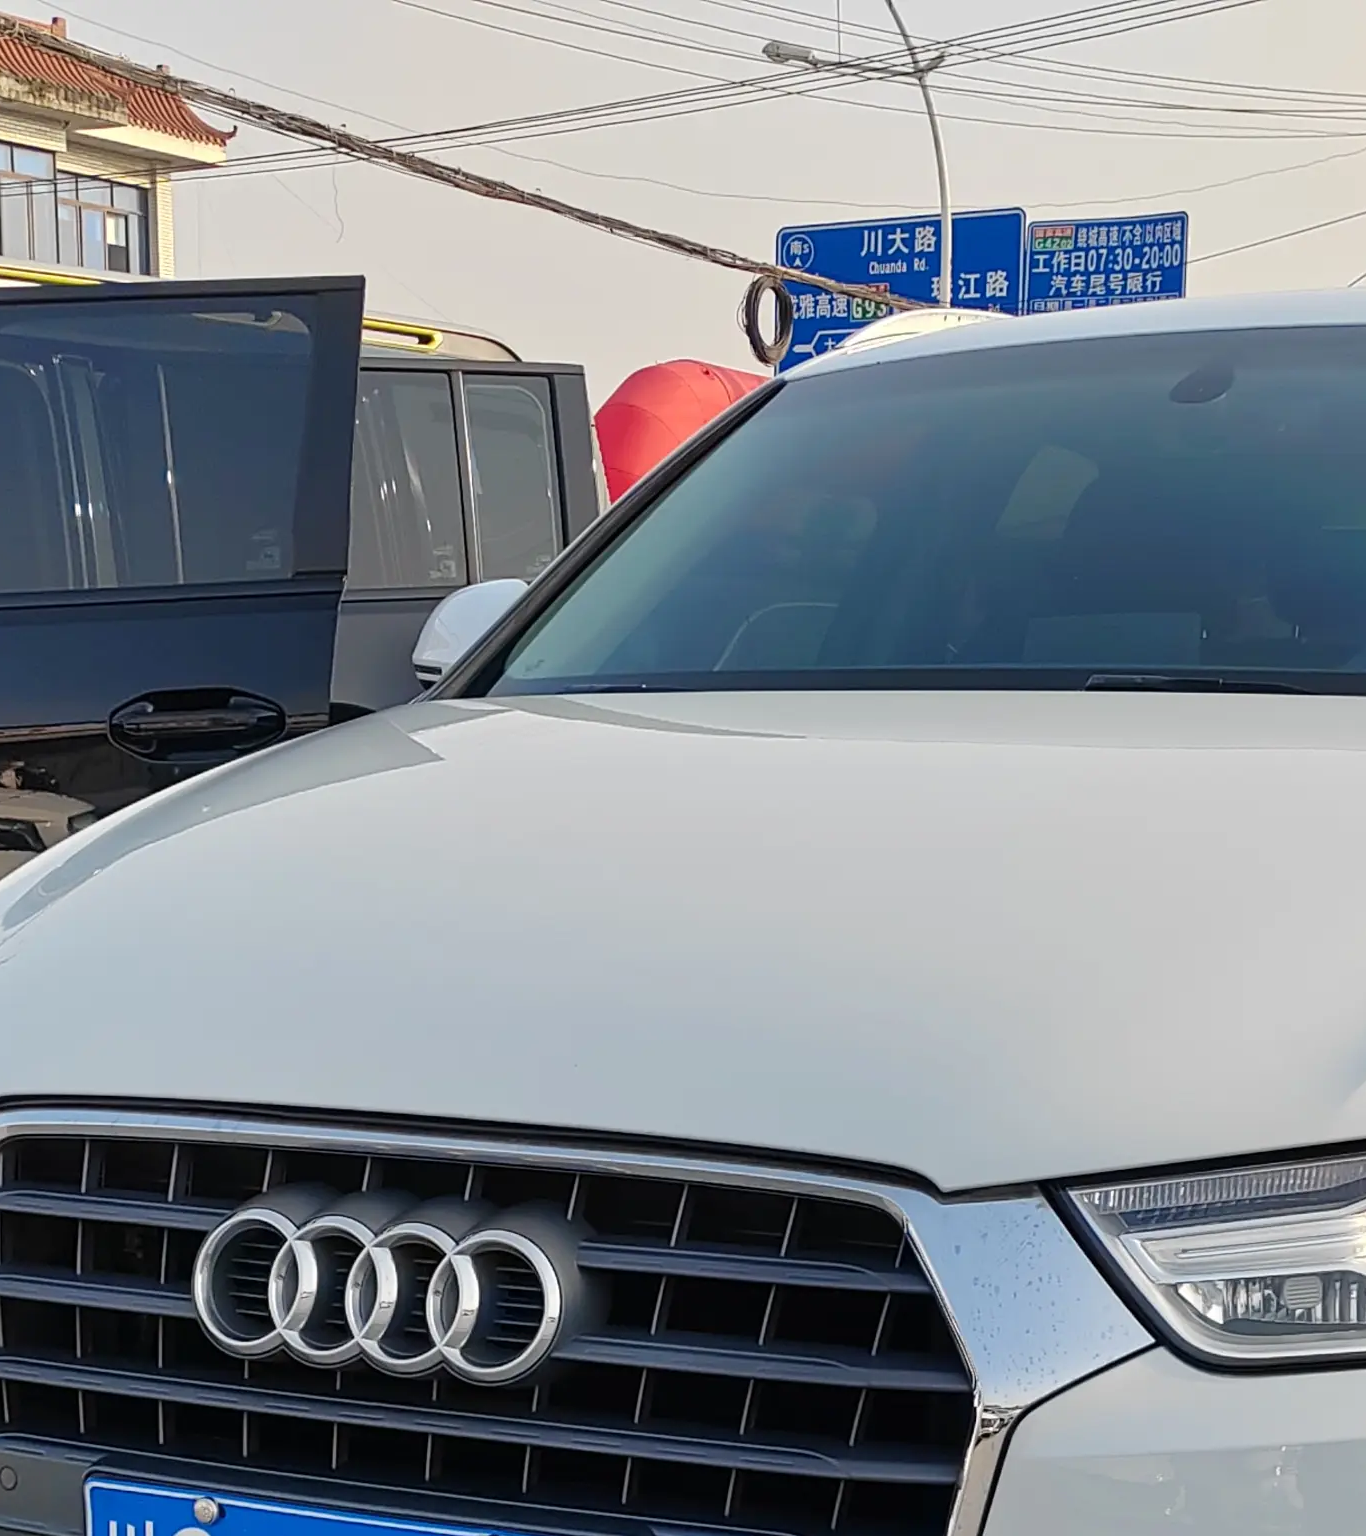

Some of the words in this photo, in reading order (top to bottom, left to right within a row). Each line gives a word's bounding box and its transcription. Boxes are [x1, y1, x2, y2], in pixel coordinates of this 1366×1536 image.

[861, 225, 937, 257] 川大路
[1035, 237, 1073, 249] G4202
[869, 259, 908, 275] Chuanda
[914, 257, 930, 272] Rd.
[1049, 271, 1163, 296] 汽车尾号限行
